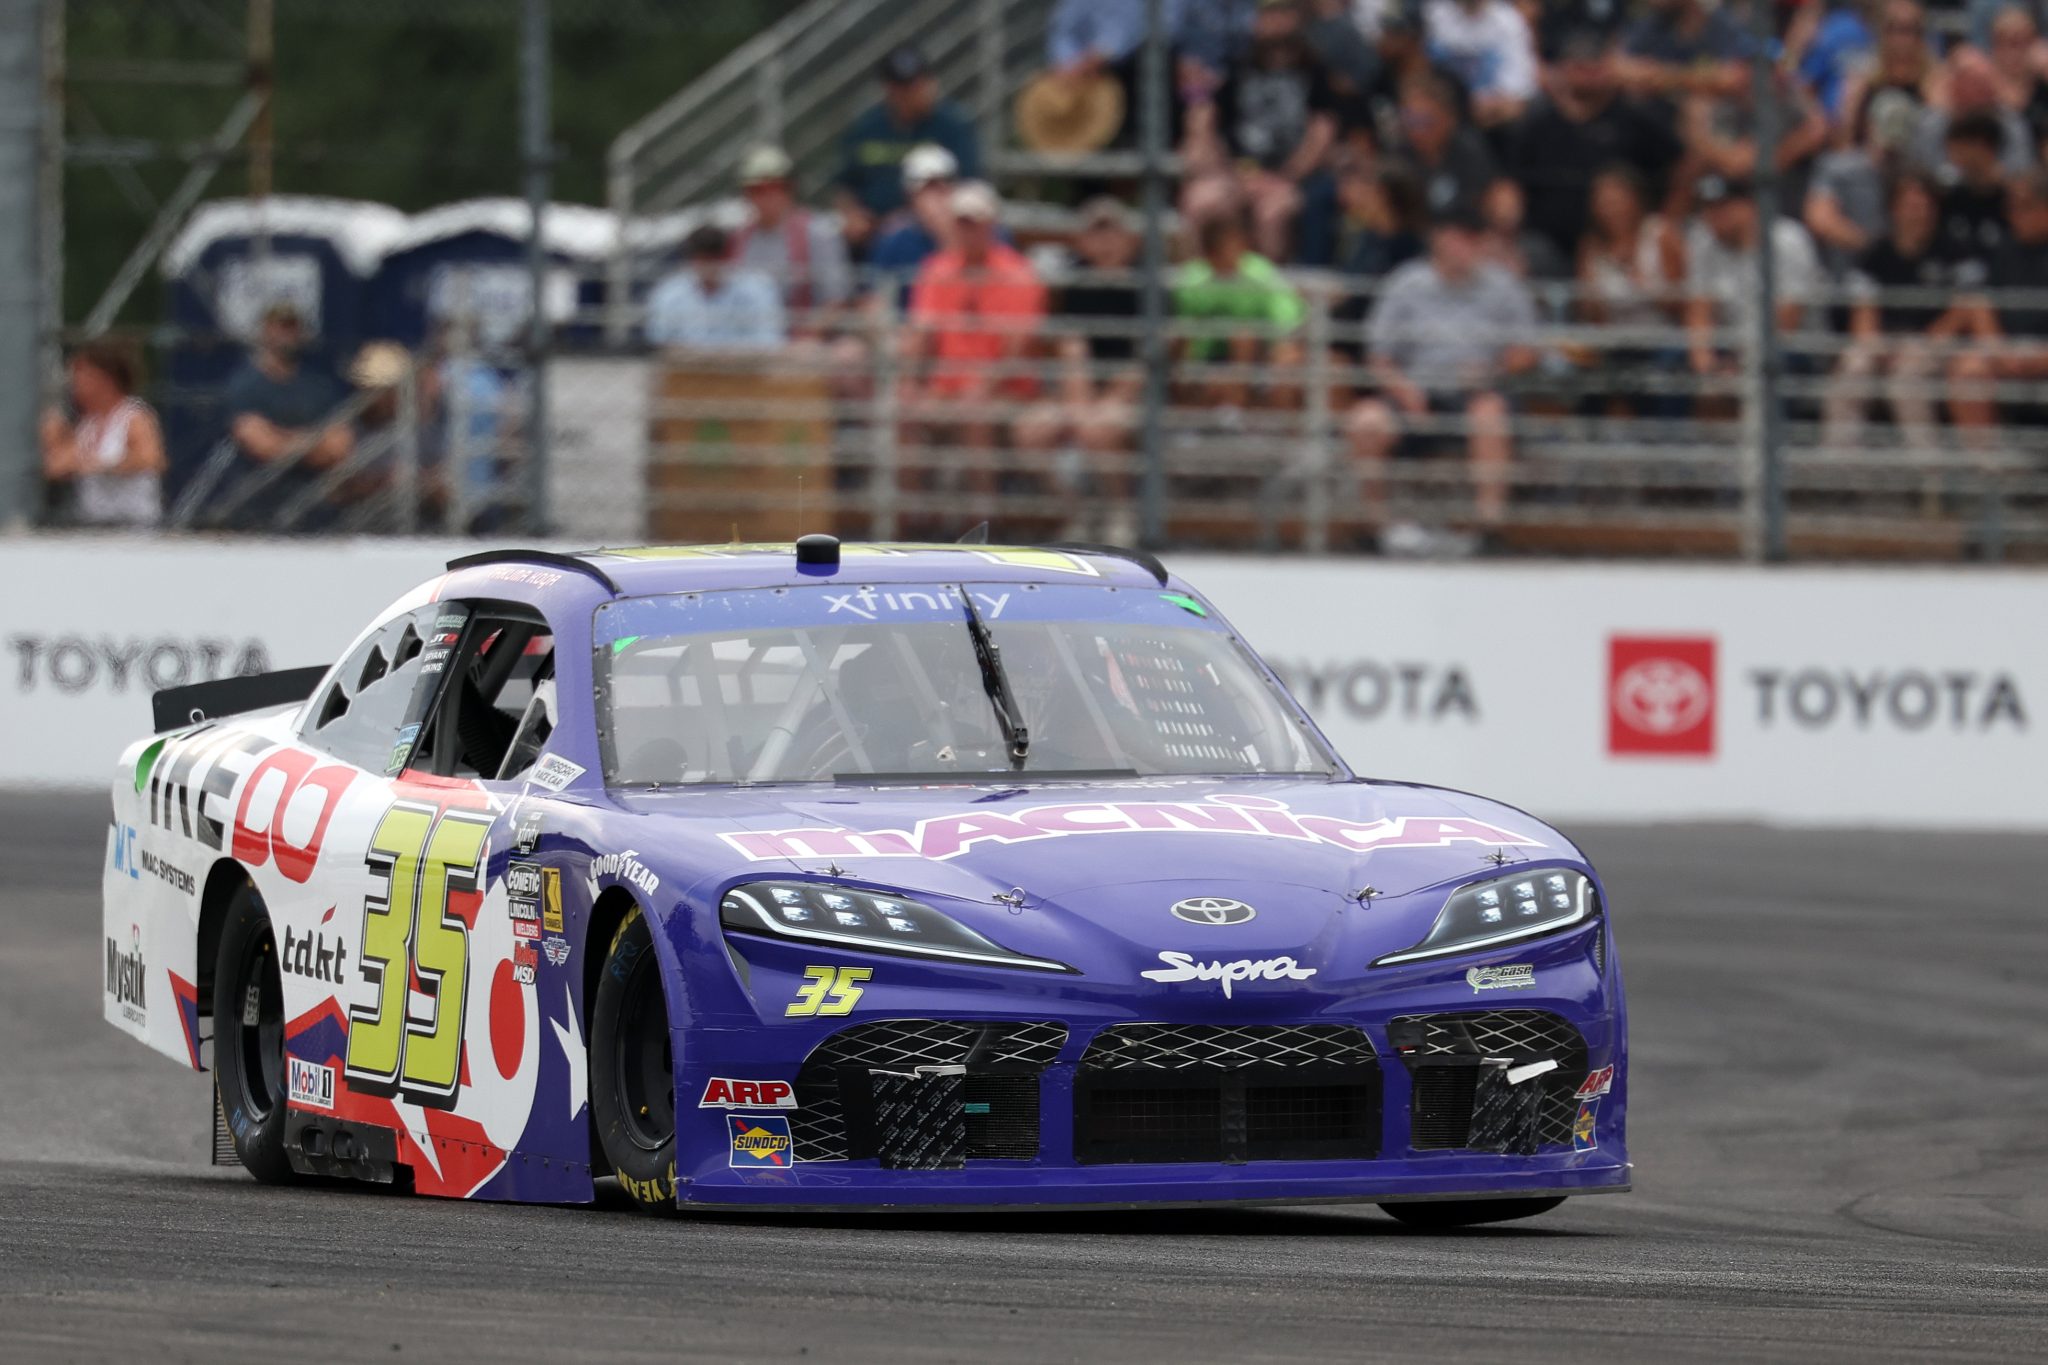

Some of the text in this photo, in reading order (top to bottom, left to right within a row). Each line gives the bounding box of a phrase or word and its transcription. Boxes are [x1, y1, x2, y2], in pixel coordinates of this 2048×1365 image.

[822, 586, 1010, 620] xfinity
[10, 635, 270, 696] TOYOTA
[1266, 658, 1480, 722] YOTA
[1746, 669, 2029, 731] TOYOTA
[142, 850, 196, 897] MAC SYSTEMS
[508, 869, 540, 894] COMETIC
[509, 901, 536, 920] LINCOLN
[106, 936, 146, 1010] Mystik
[346, 800, 498, 1112] 35
[513, 964, 535, 984] MSD
[1141, 950, 1317, 999] Supra
[785, 965, 873, 1017] 35
[291, 1060, 321, 1098] Mobil
[703, 1079, 792, 1105] ARP
[1578, 1066, 1613, 1095] ARP
[735, 1135, 789, 1151] SUNOCO
